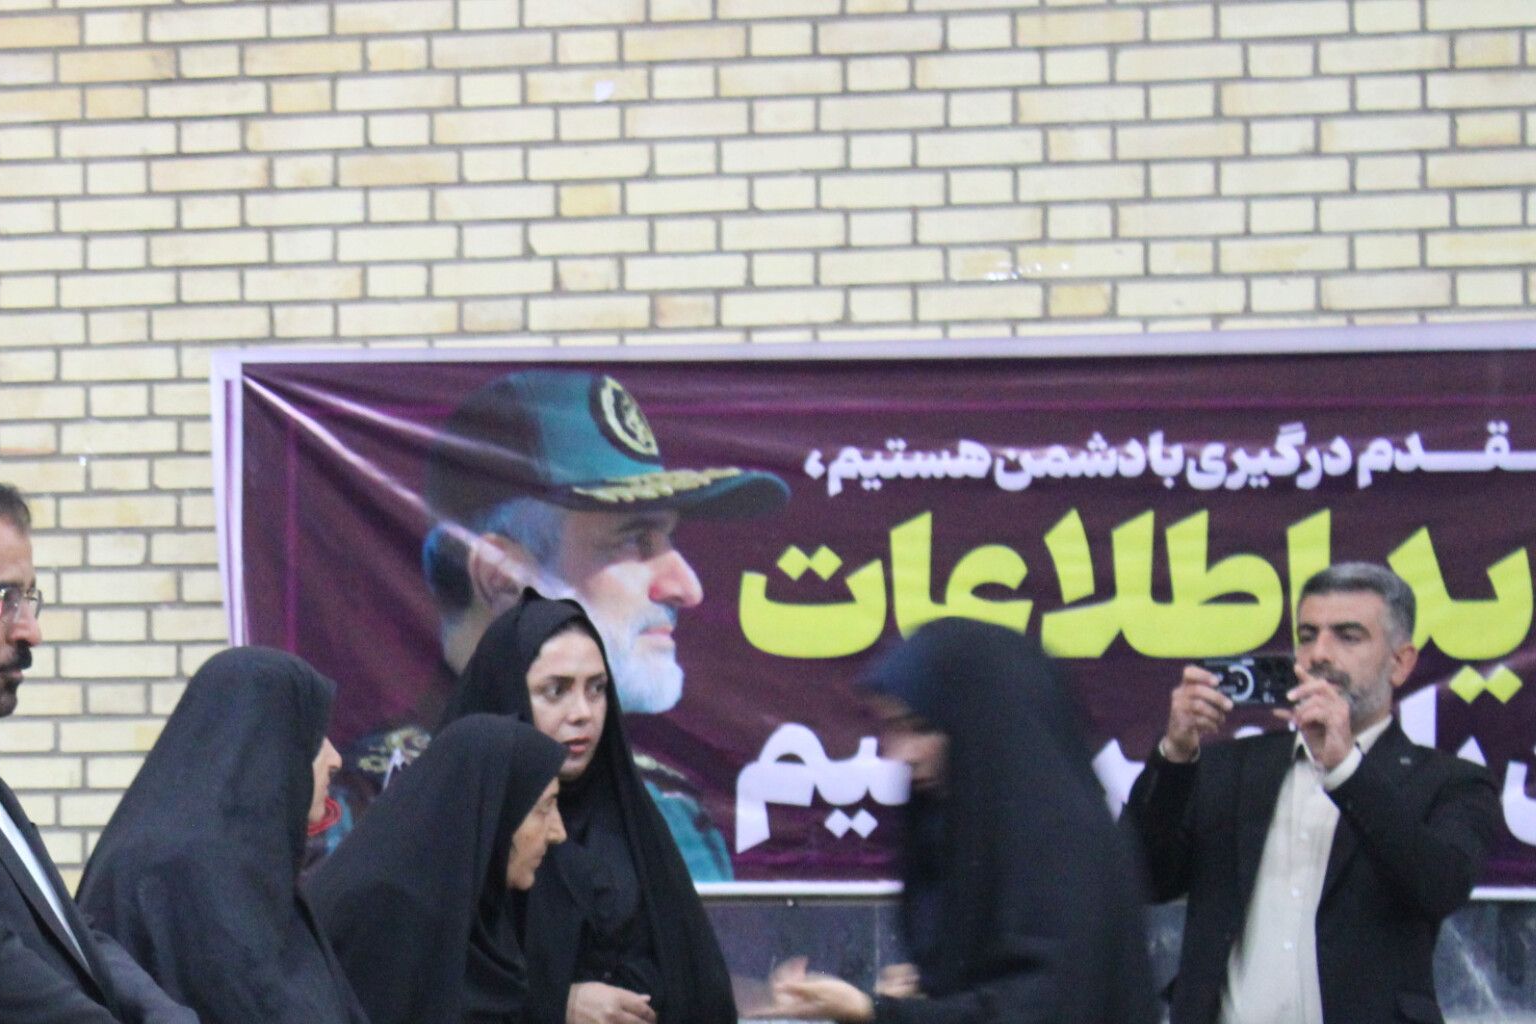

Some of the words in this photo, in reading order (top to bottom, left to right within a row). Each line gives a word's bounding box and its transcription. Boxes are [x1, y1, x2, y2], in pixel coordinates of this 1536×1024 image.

[994, 431, 1147, 491] دشمن
[1148, 430, 1185, 490] با
[1186, 421, 1352, 490] درگیری
[1357, 421, 1536, 488] قدم
[739, 507, 1332, 659] اطلاعات
